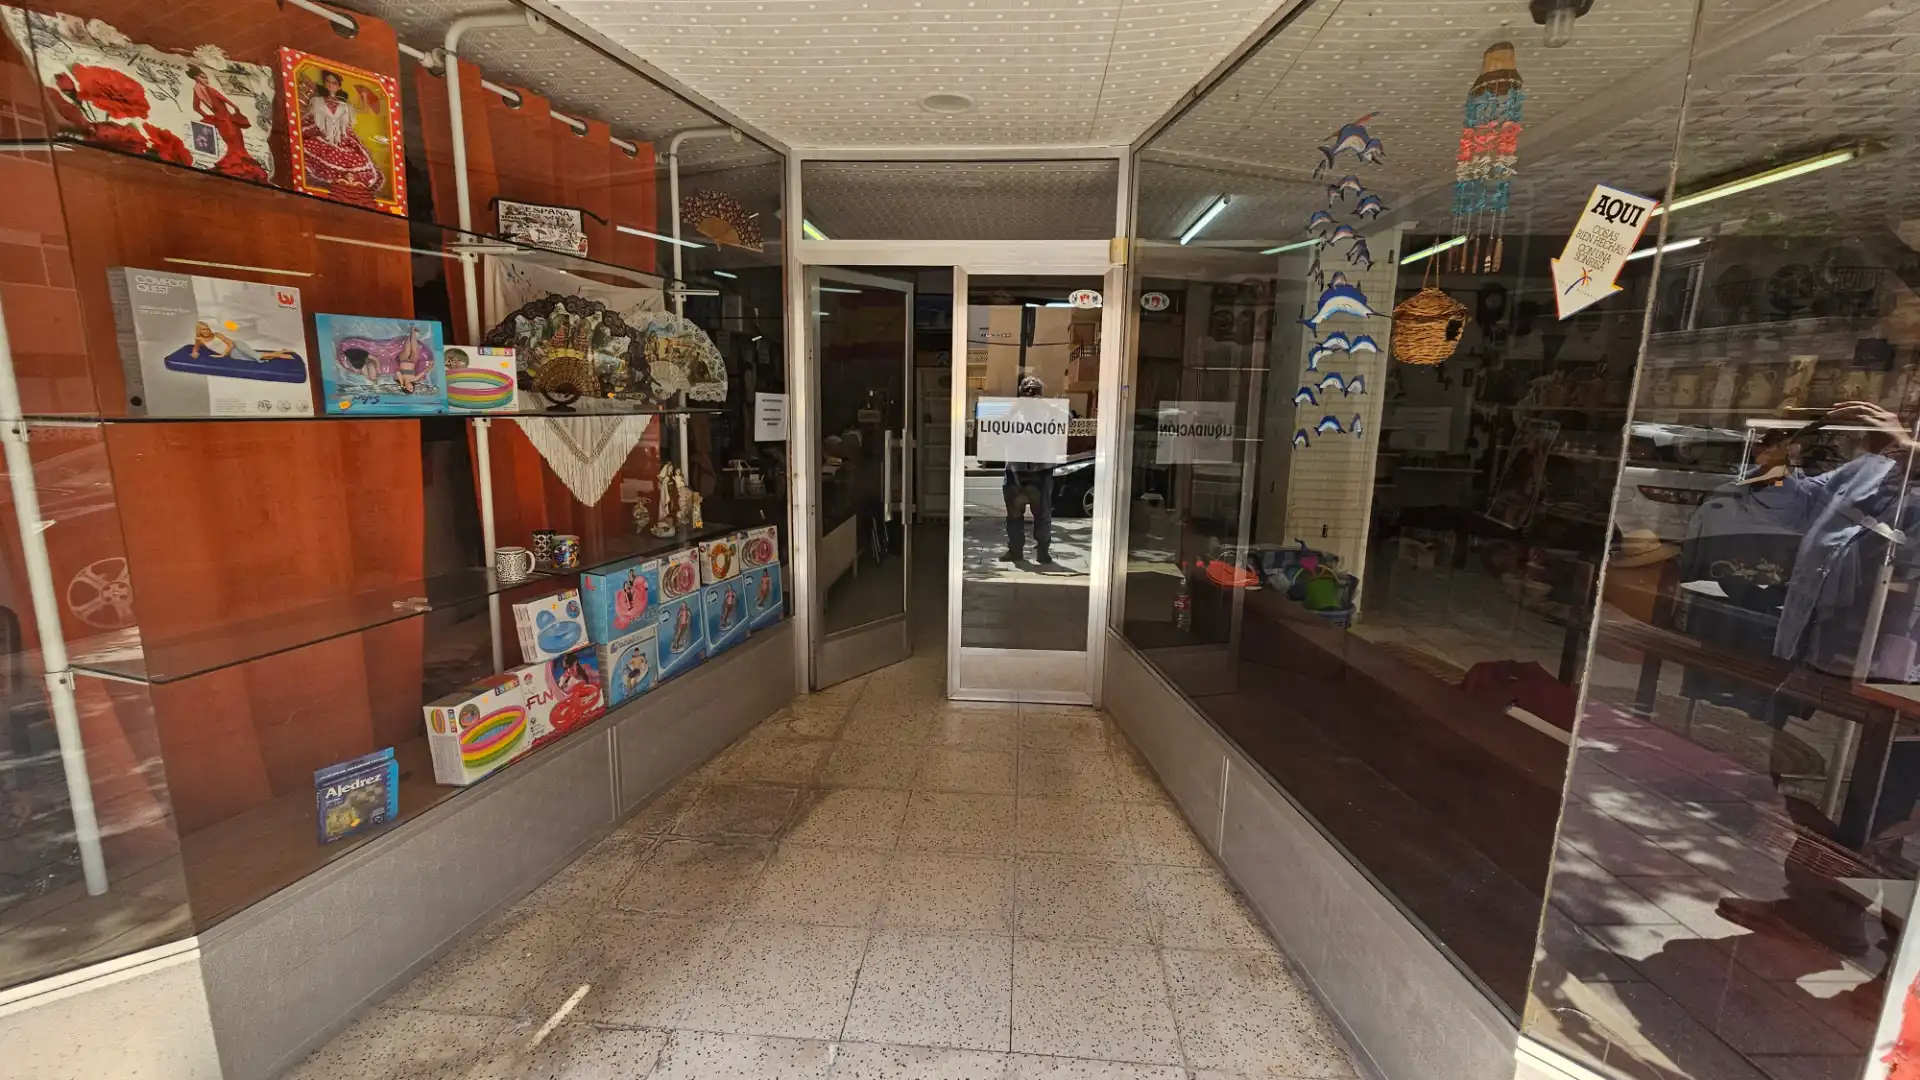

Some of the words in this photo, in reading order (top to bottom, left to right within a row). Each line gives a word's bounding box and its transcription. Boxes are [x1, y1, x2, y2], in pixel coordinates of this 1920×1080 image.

[1591, 195, 1645, 227] AQUI
[1576, 229, 1594, 244] BIEN
[1594, 235, 1627, 256] HECHAS
[1592, 224, 1620, 242] COSAS
[1574, 252, 1605, 272] SONRISA
[1577, 243, 1596, 259] CON
[1594, 249, 1612, 264] UNA
[135, 274, 189, 289] COMFORT
[136, 284, 170, 295] QUEST
[980, 419, 1067, 436] LIQUIDACIÓN
[525, 689, 554, 711] FUN
[325, 774, 382, 799] Ajedrez
